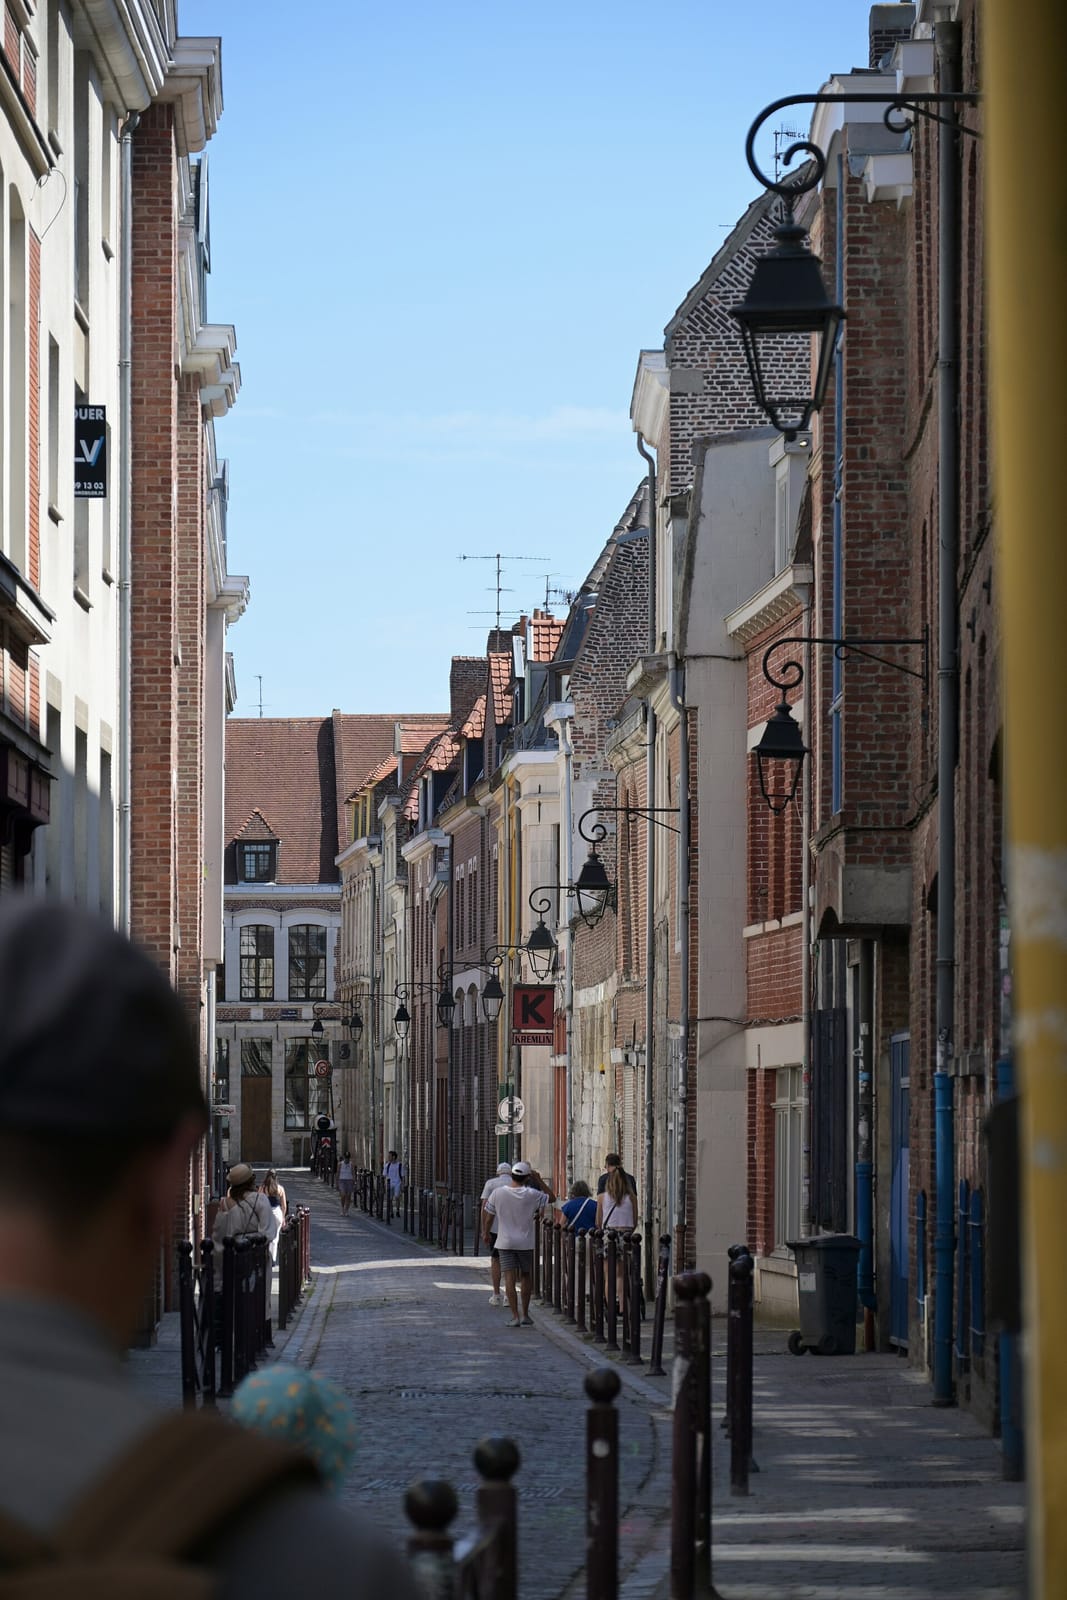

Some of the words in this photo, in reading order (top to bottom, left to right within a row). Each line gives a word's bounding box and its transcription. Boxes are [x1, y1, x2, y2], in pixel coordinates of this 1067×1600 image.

[93, 482, 104, 490] 03
[522, 994, 546, 1024] K
[515, 1036, 552, 1044] KREMLIN
